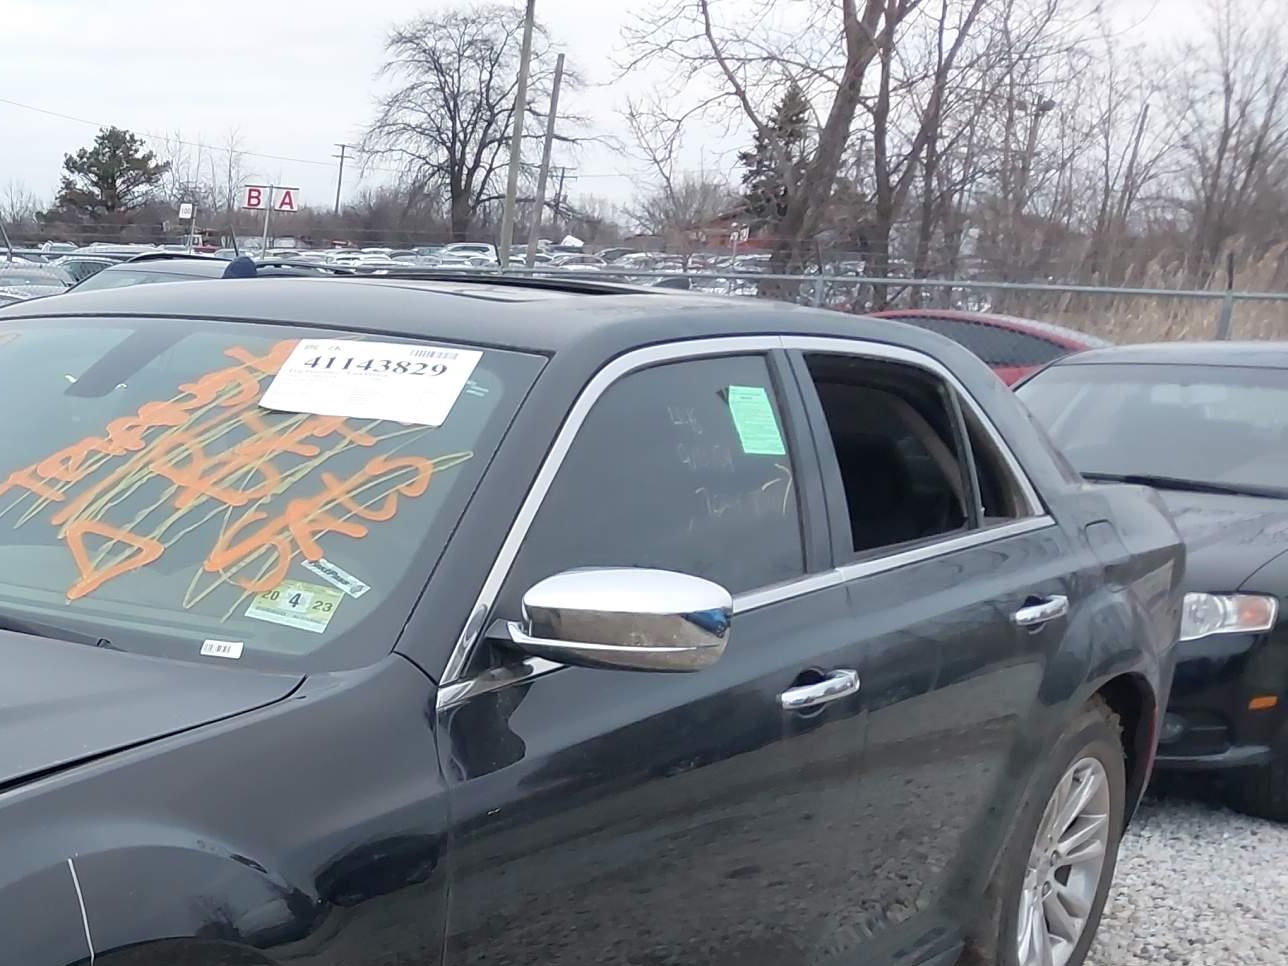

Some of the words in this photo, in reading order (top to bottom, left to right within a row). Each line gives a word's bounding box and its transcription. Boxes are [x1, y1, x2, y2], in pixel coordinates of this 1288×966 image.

[247, 188, 262, 207] B
[278, 190, 294, 210] A
[303, 355, 448, 377] 41143829
[288, 593, 302, 608] 4
[312, 600, 333, 612] 23
